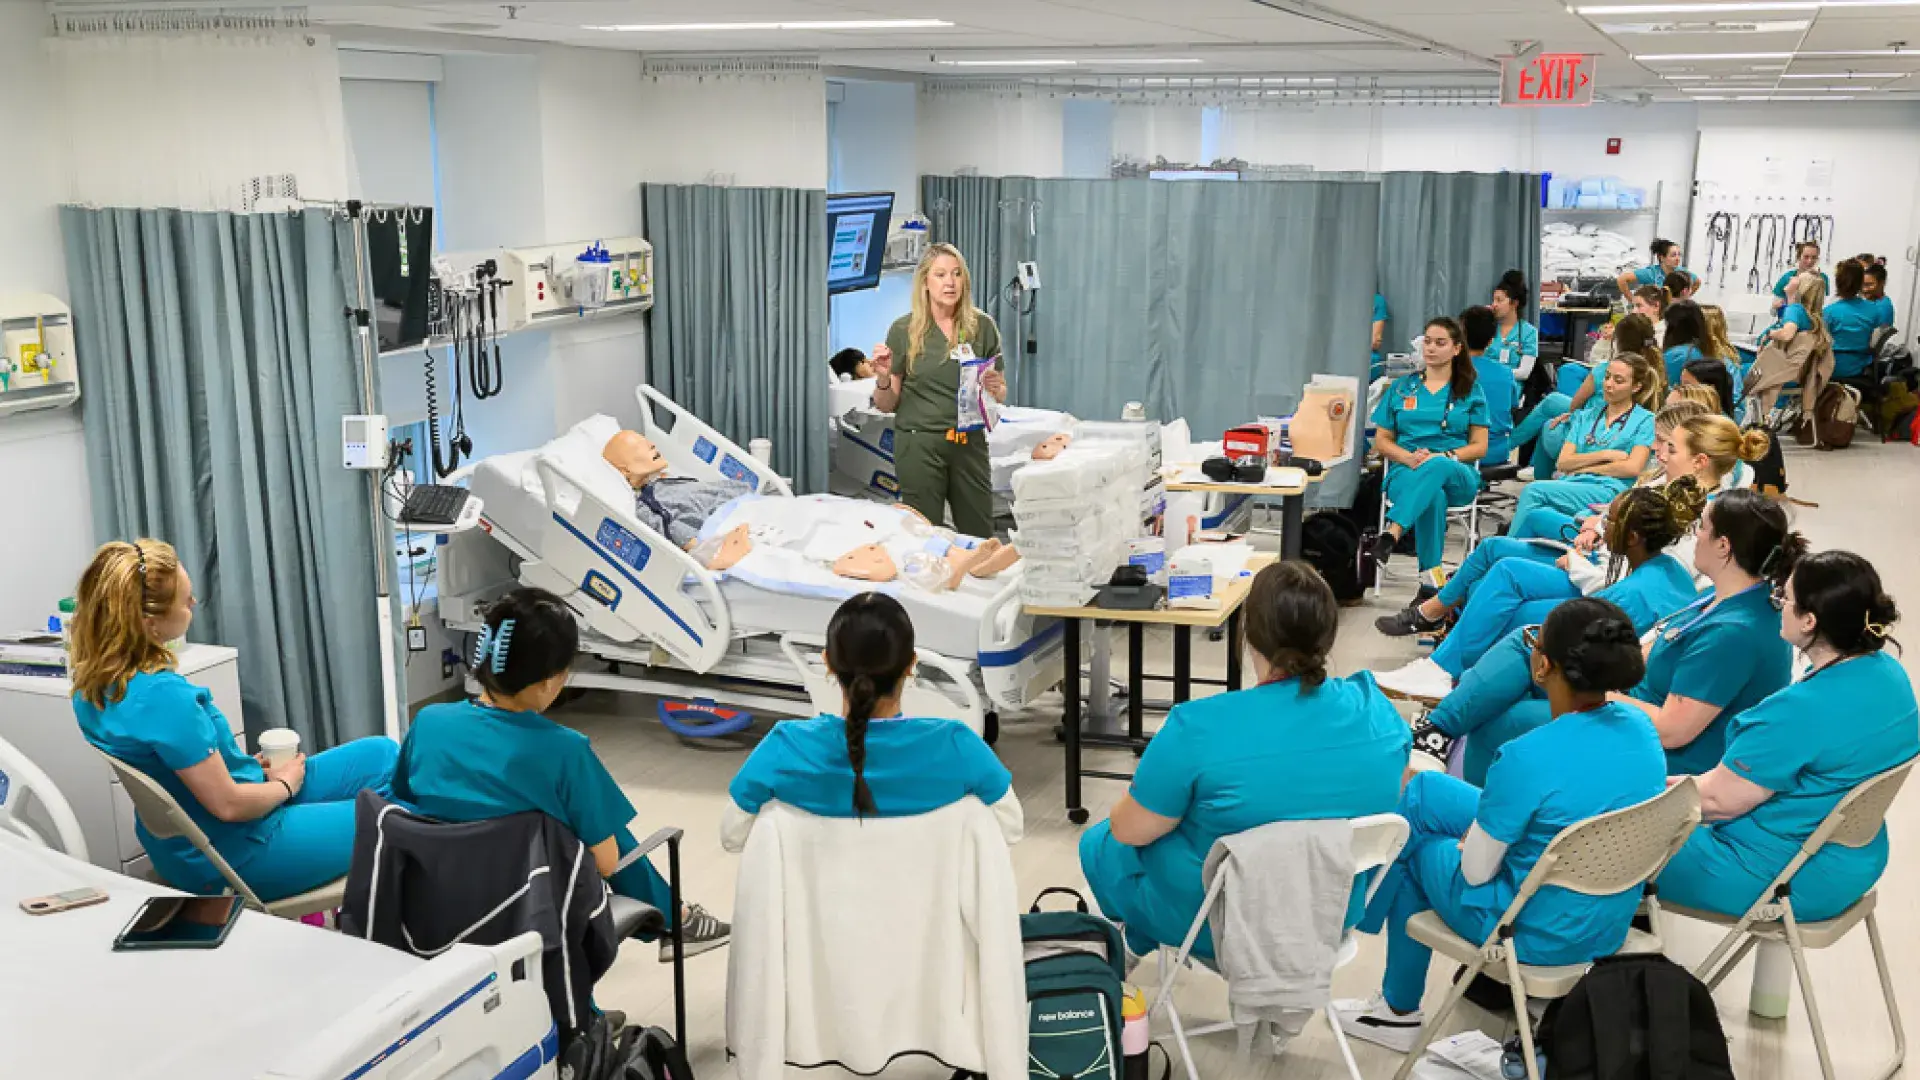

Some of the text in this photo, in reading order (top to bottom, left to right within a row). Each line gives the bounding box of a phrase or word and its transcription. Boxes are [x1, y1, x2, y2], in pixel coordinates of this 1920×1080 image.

[1518, 58, 1582, 99] EXIT
[1038, 1010, 1095, 1022] new balance
